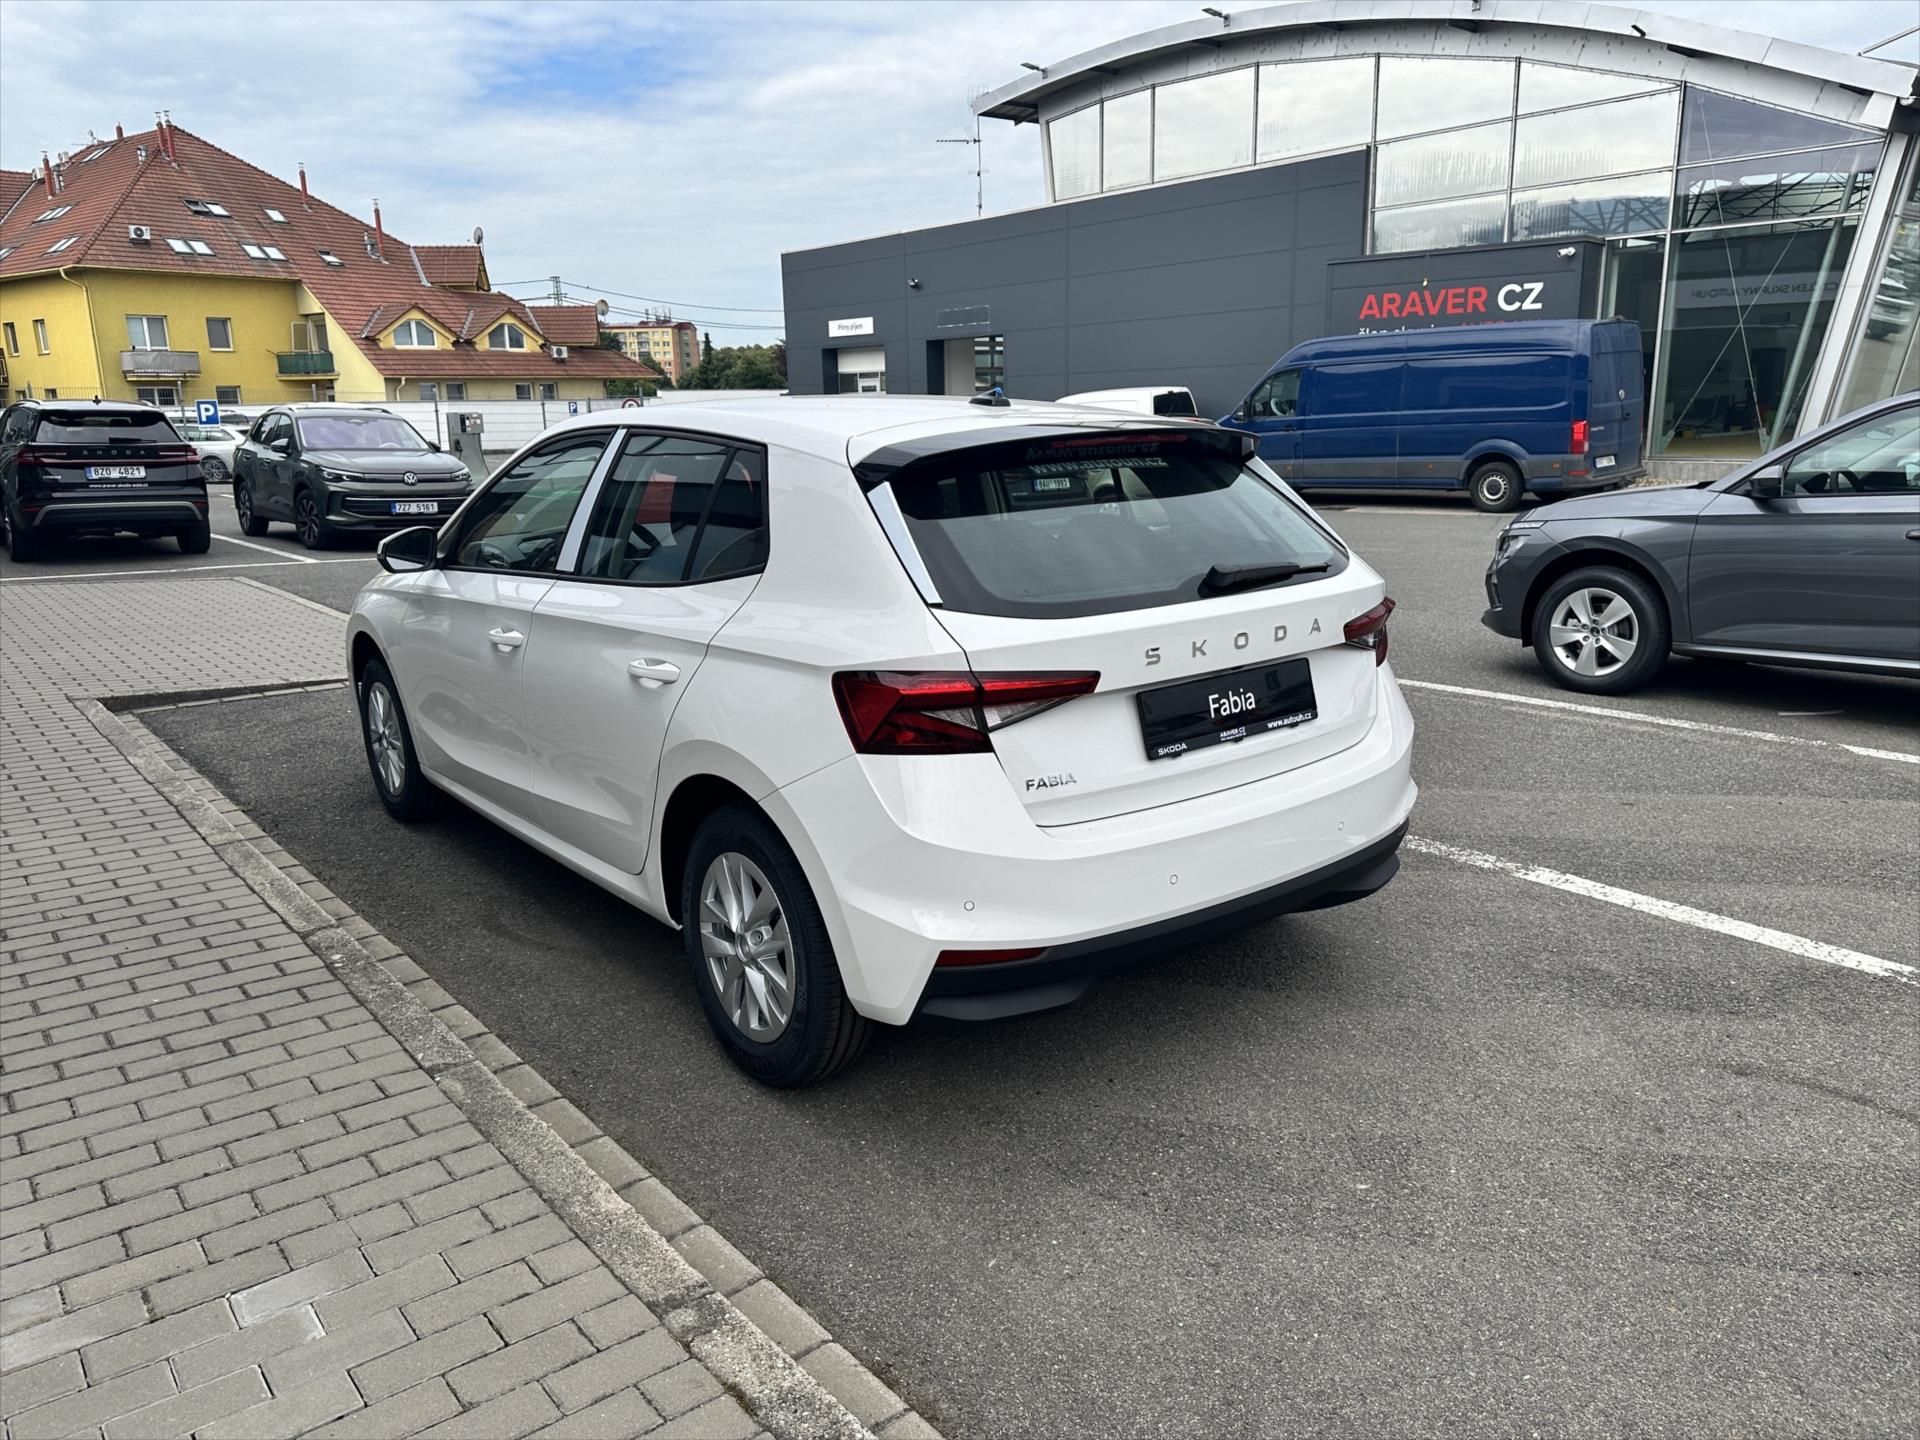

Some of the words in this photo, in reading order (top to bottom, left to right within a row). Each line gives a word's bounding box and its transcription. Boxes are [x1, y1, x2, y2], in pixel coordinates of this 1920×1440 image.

[1358, 286, 1489, 320] ARAVER
[1497, 281, 1545, 312] CZ
[200, 404, 215, 422] P
[118, 466, 142, 476] 4821
[1208, 688, 1256, 719] Fabia
[1266, 712, 1312, 729] www.autouh.cz
[1025, 773, 1077, 791] FABIA
